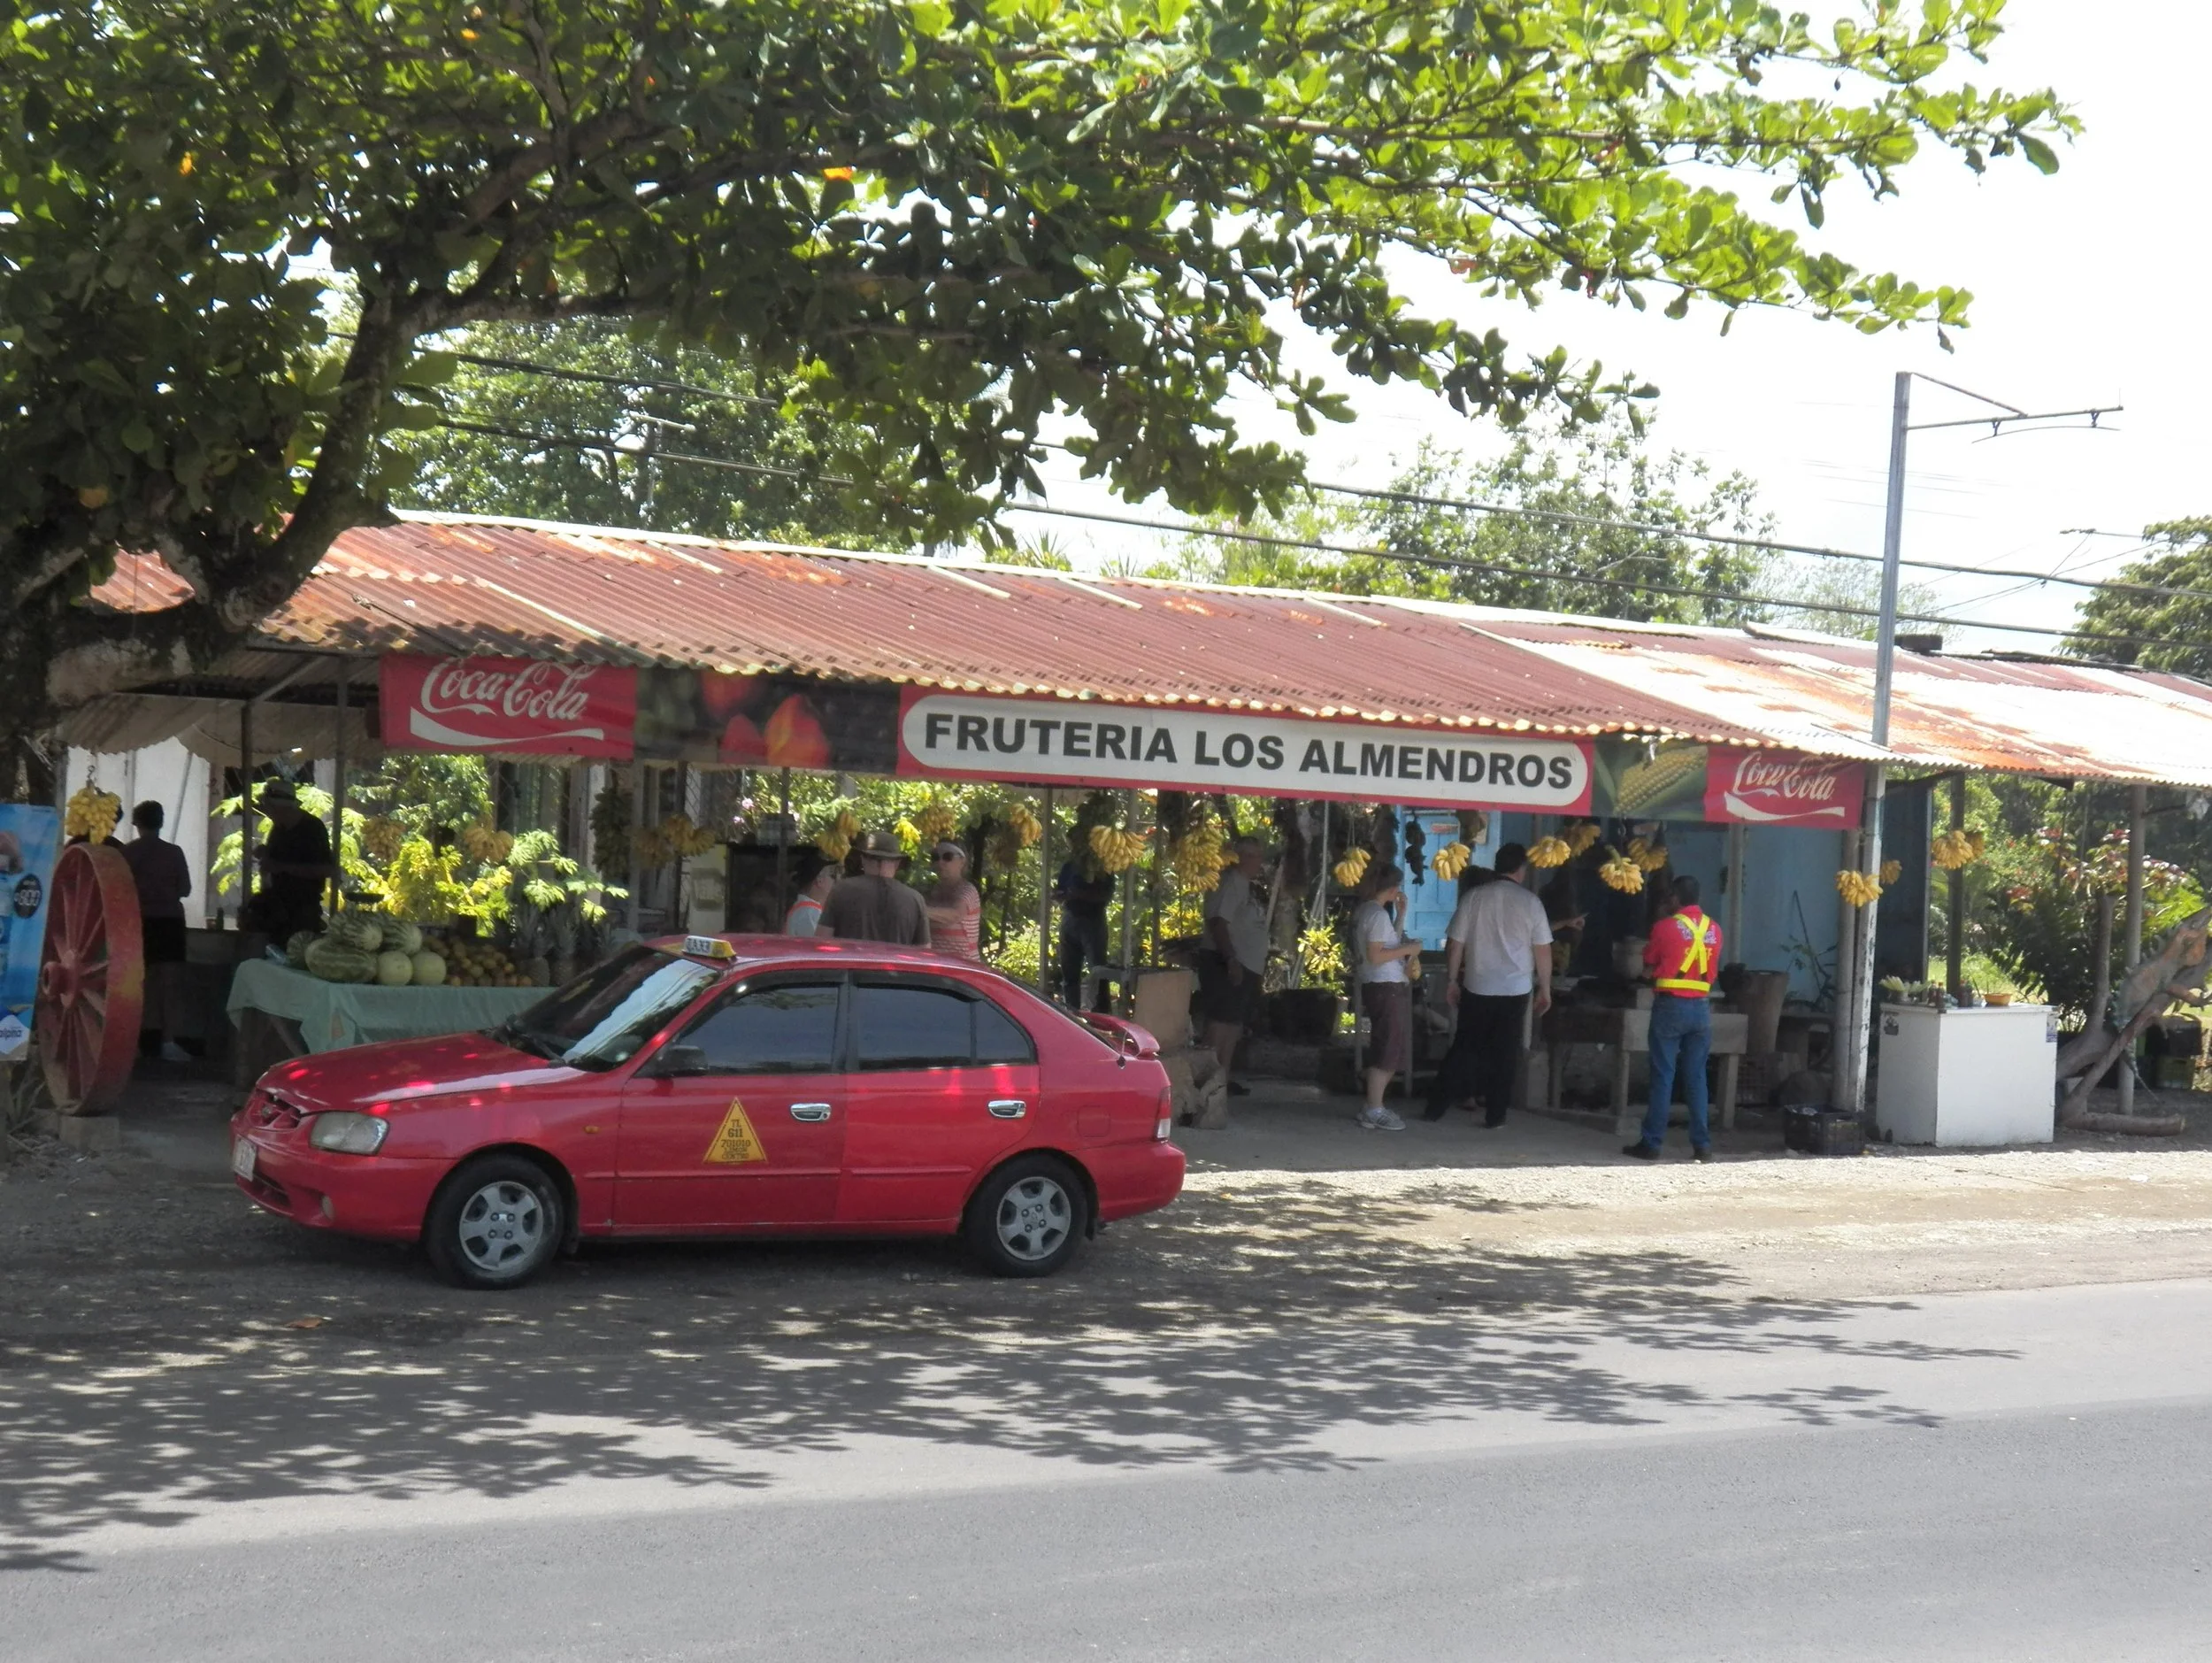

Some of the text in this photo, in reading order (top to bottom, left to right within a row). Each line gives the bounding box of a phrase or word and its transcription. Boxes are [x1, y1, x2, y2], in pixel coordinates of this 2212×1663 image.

[420, 657, 597, 721] Coca-Cola
[925, 712, 1572, 789] FRUTERIA LOS ALMENDROS
[727, 1128, 743, 1138] 611
